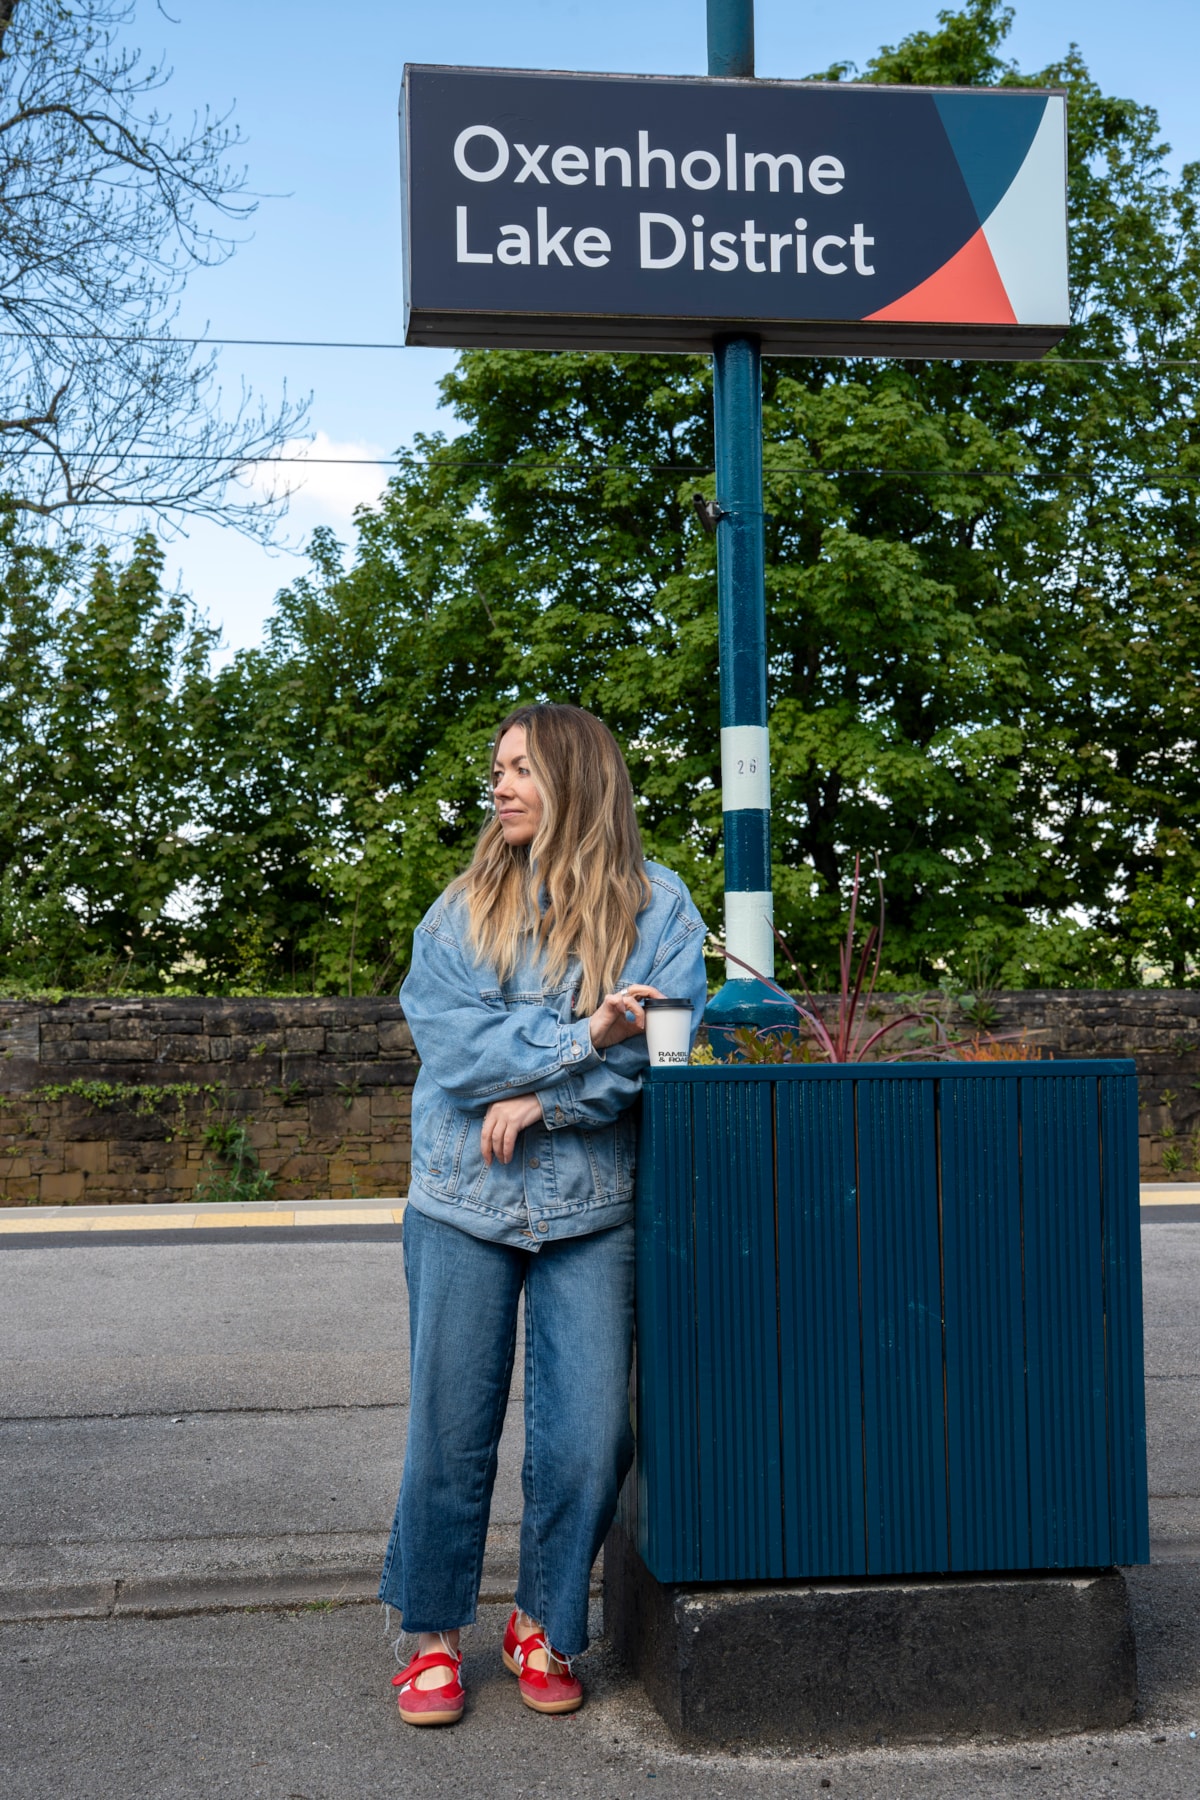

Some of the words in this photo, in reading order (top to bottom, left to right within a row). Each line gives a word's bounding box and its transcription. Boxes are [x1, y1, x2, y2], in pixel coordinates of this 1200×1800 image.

[453, 124, 846, 195] Oxenholme
[456, 205, 612, 268] Lake
[639, 212, 876, 276] District
